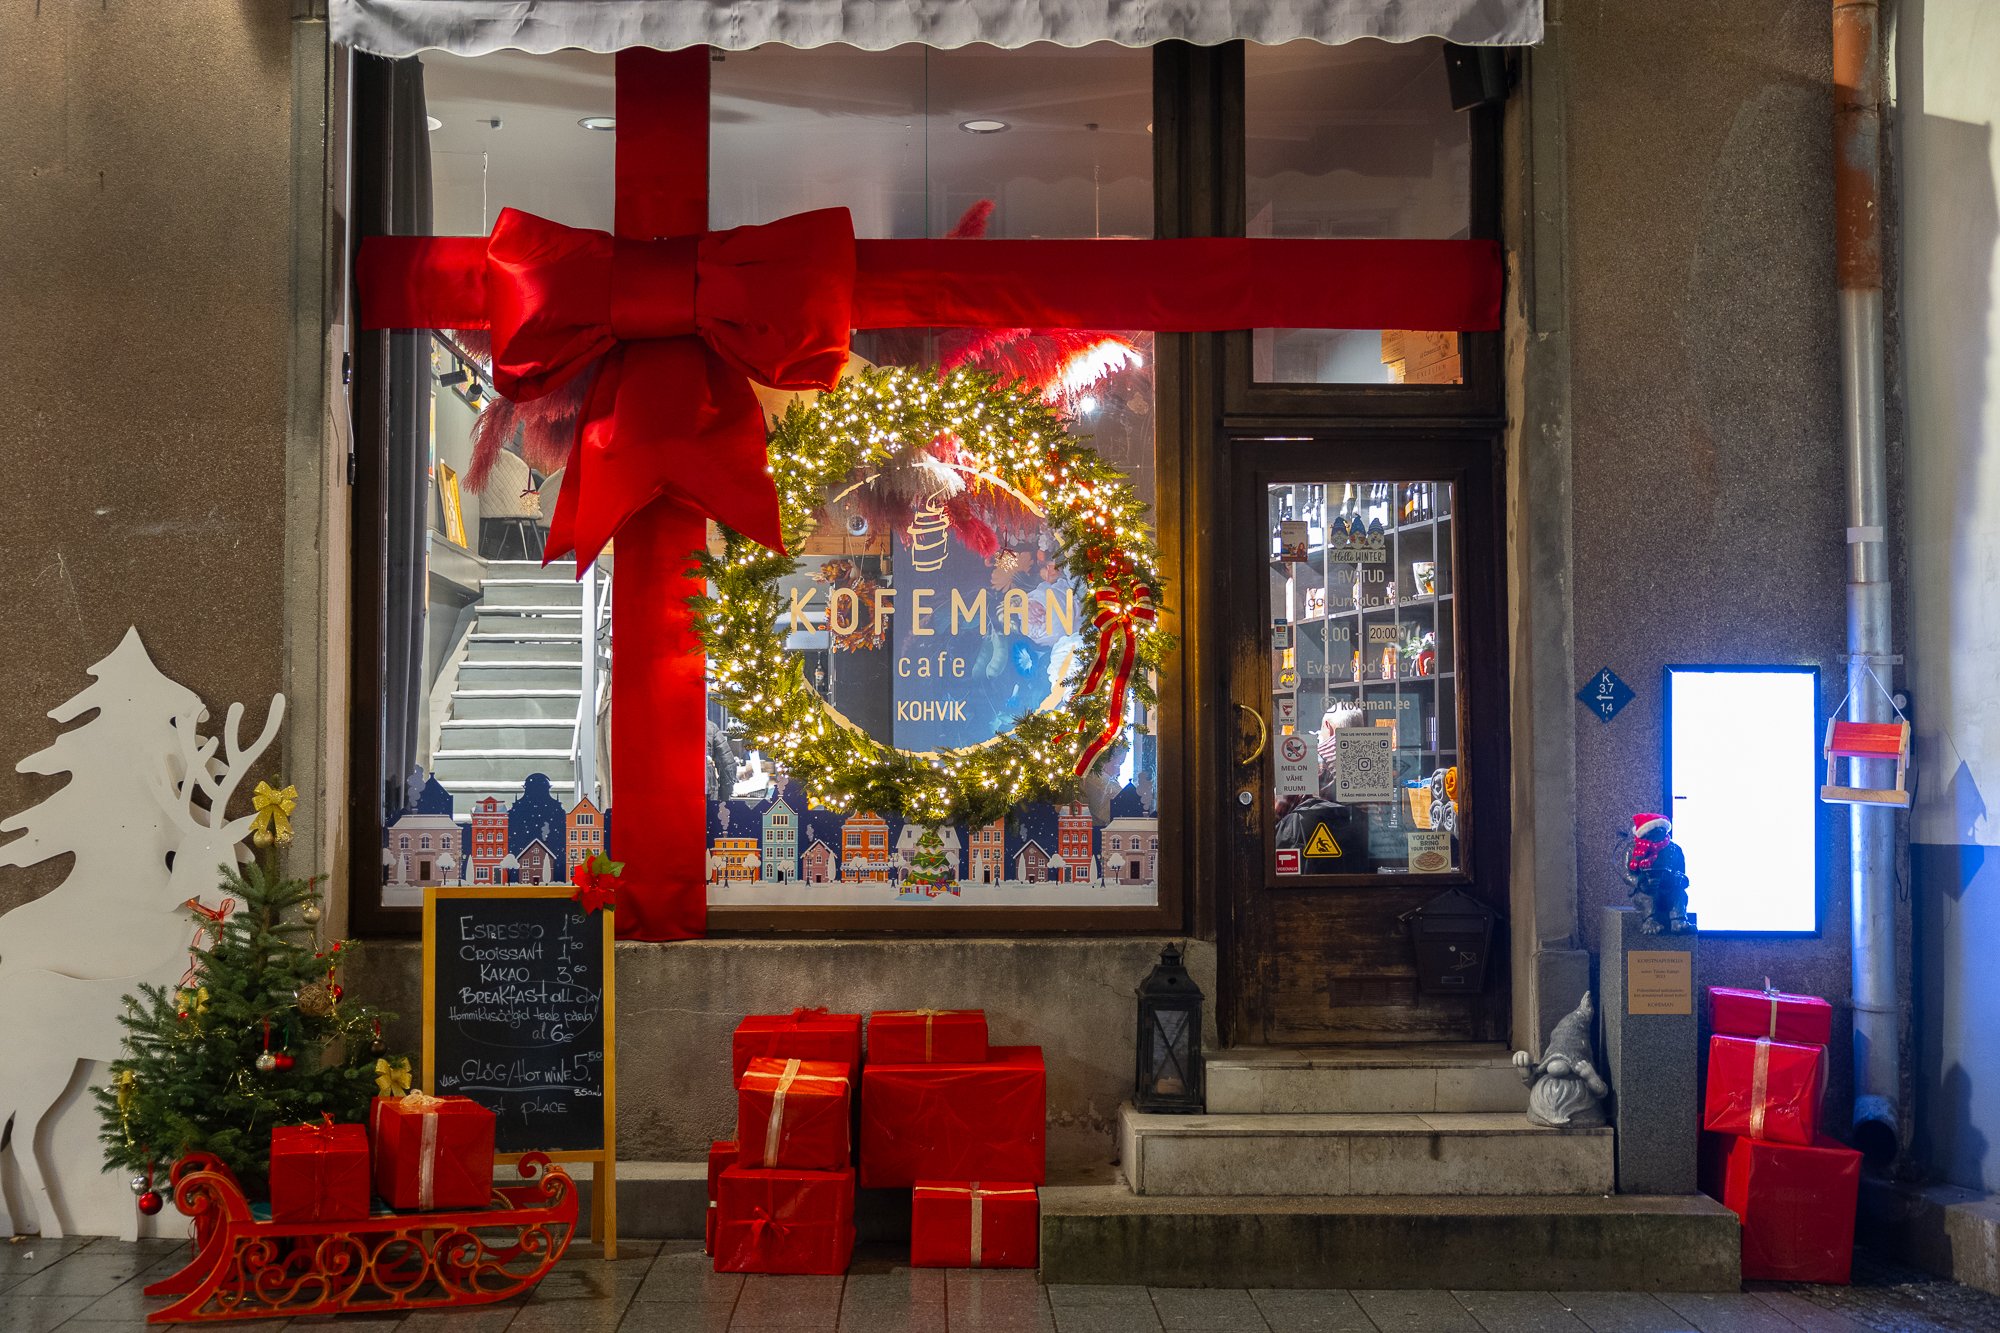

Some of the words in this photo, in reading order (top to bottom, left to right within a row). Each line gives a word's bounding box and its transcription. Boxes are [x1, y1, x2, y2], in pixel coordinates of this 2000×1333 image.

[1333, 551, 1354, 561] Hello
[1355, 551, 1382, 562] WINTER
[1337, 569, 1385, 583] AVATUD
[1328, 594, 1379, 607] Jumala
[790, 587, 1073, 636] KOFEMAN
[1320, 627, 1350, 642] 9.00
[1370, 627, 1397, 640] 20:00
[898, 651, 966, 678] cafe
[1307, 660, 1345, 677] Every
[1602, 673, 1610, 682] K
[897, 700, 967, 722] KOHVIK
[1340, 697, 1410, 711] kofeman.ee
[480, 963, 530, 984] KAKAO
